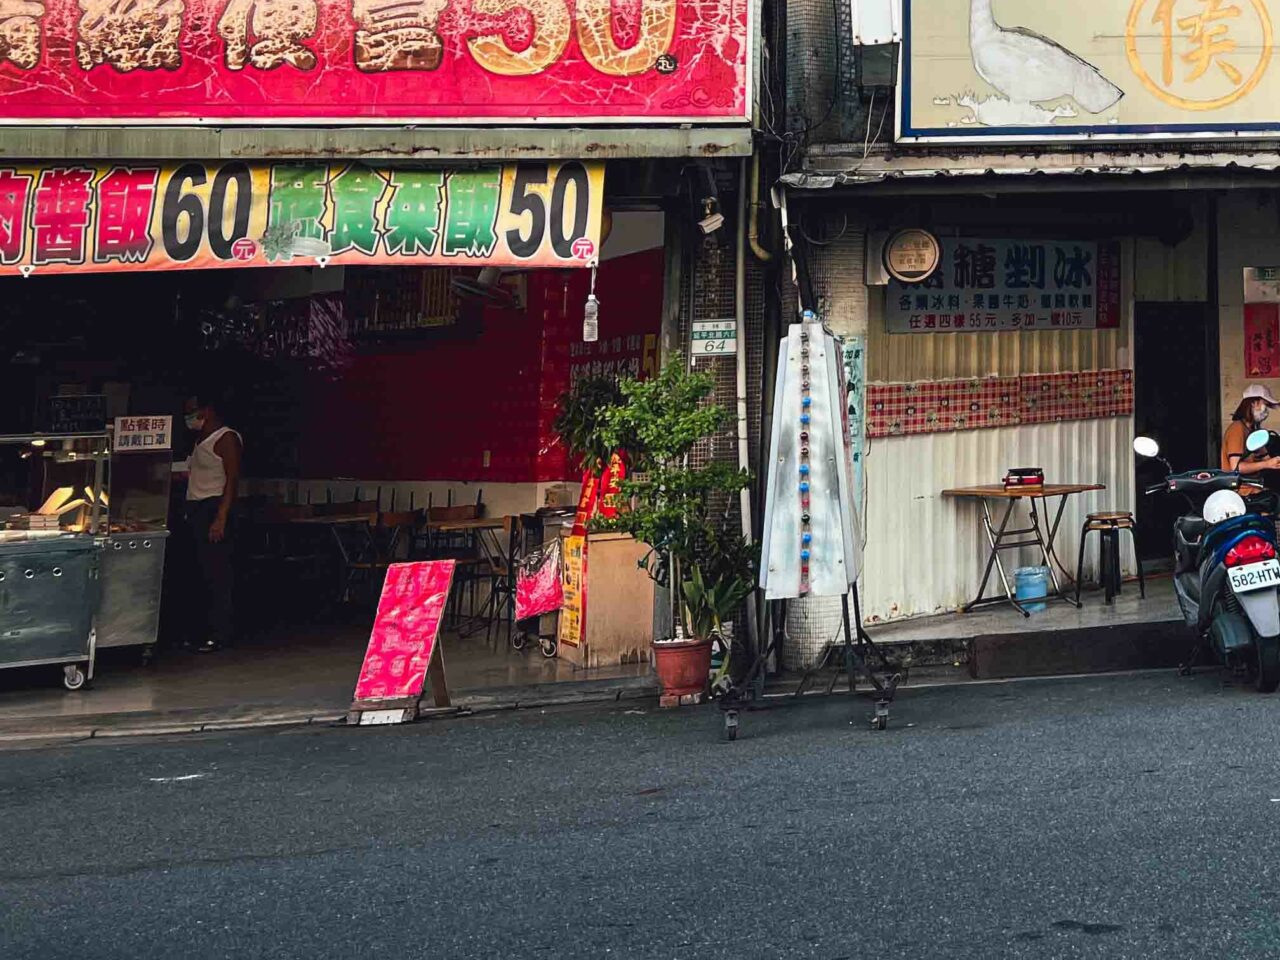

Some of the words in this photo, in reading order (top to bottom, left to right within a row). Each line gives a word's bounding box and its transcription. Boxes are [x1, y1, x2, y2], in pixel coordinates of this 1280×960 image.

[161, 161, 252, 263] 60
[234, 240, 256, 260] 元
[505, 160, 590, 260] 50
[574, 240, 594, 259] 元
[704, 340, 726, 352] 64
[119, 418, 167, 433] 點餐時
[117, 433, 167, 448] 請戴口罩
